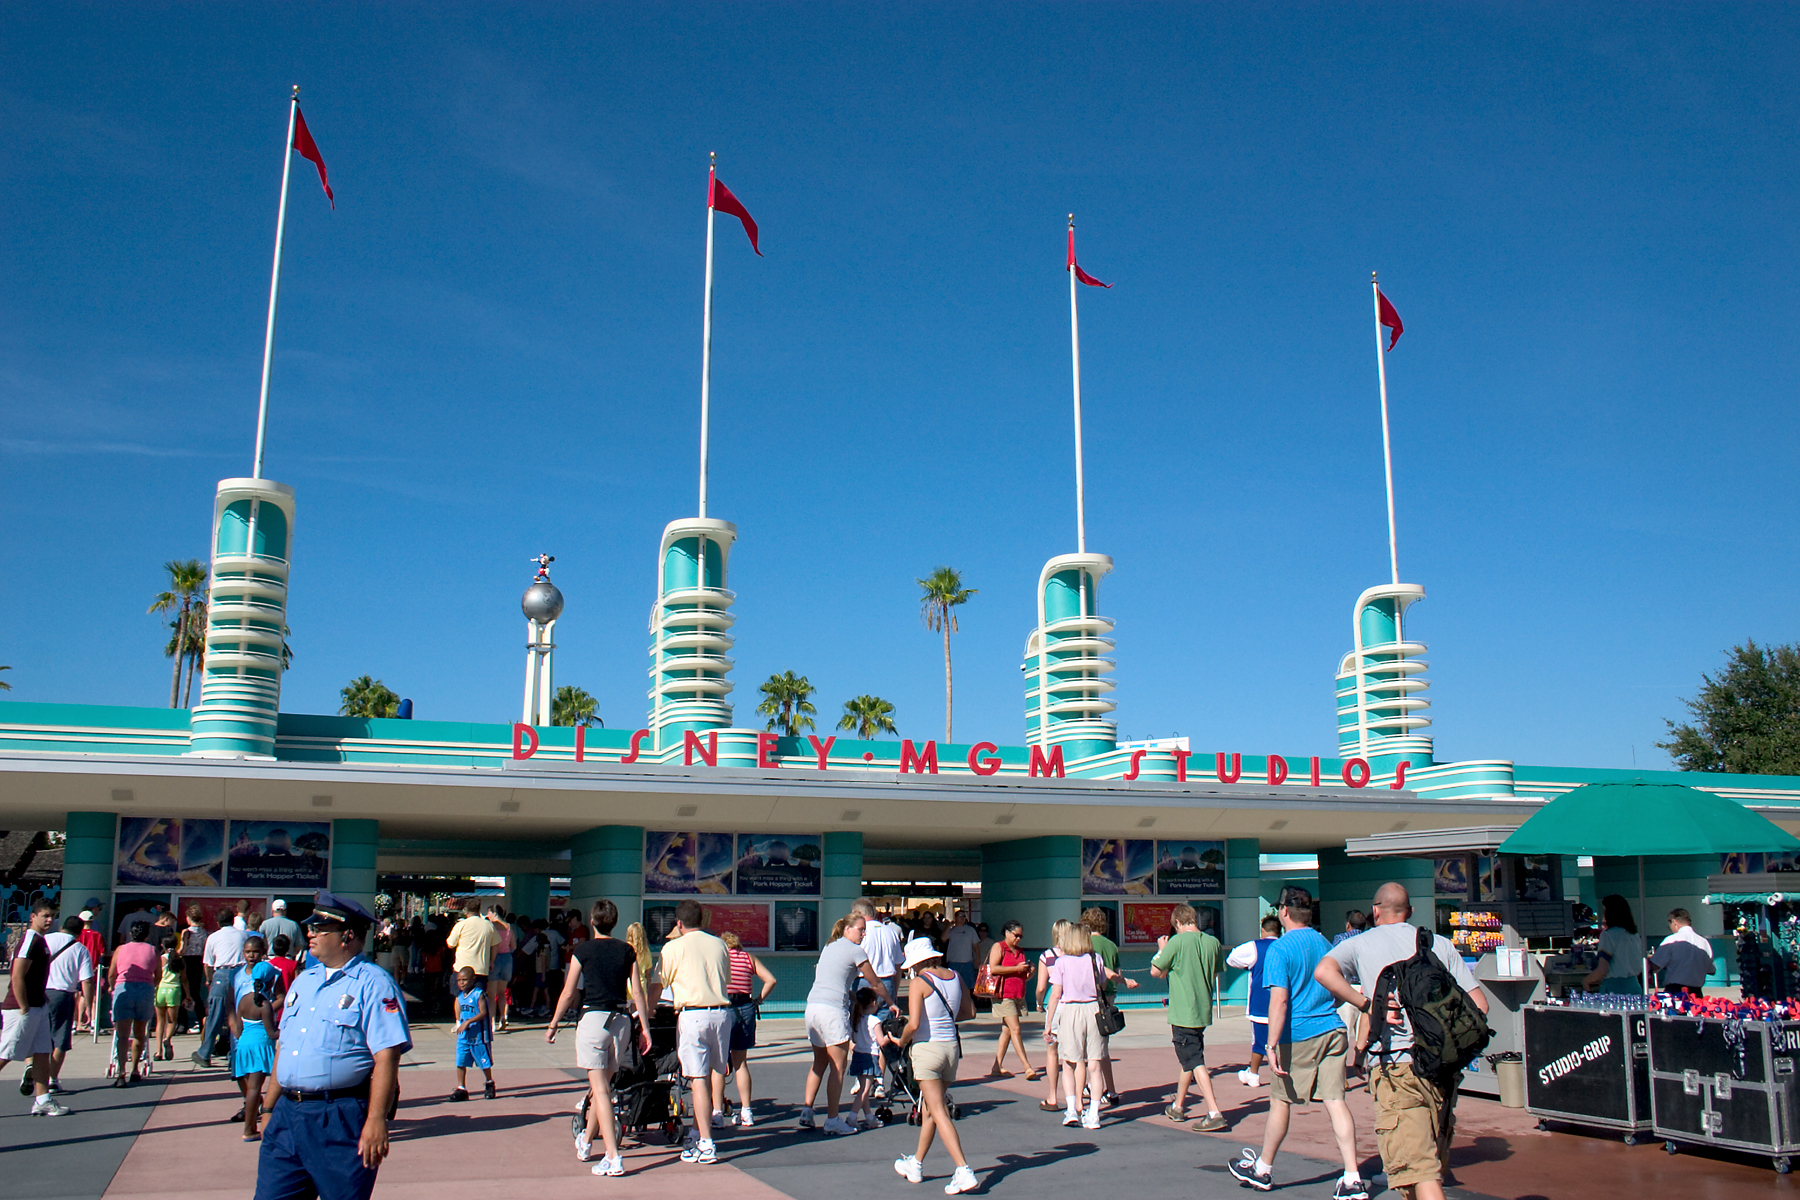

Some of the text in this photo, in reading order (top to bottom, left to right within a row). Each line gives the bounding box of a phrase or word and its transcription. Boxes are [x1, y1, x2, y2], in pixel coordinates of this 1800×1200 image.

[512, 723, 1410, 790] DISNEY MGM STUDIOS
[461, 1004, 475, 1013] EST
[1539, 1035, 1611, 1085] STUDIO-GRIP
